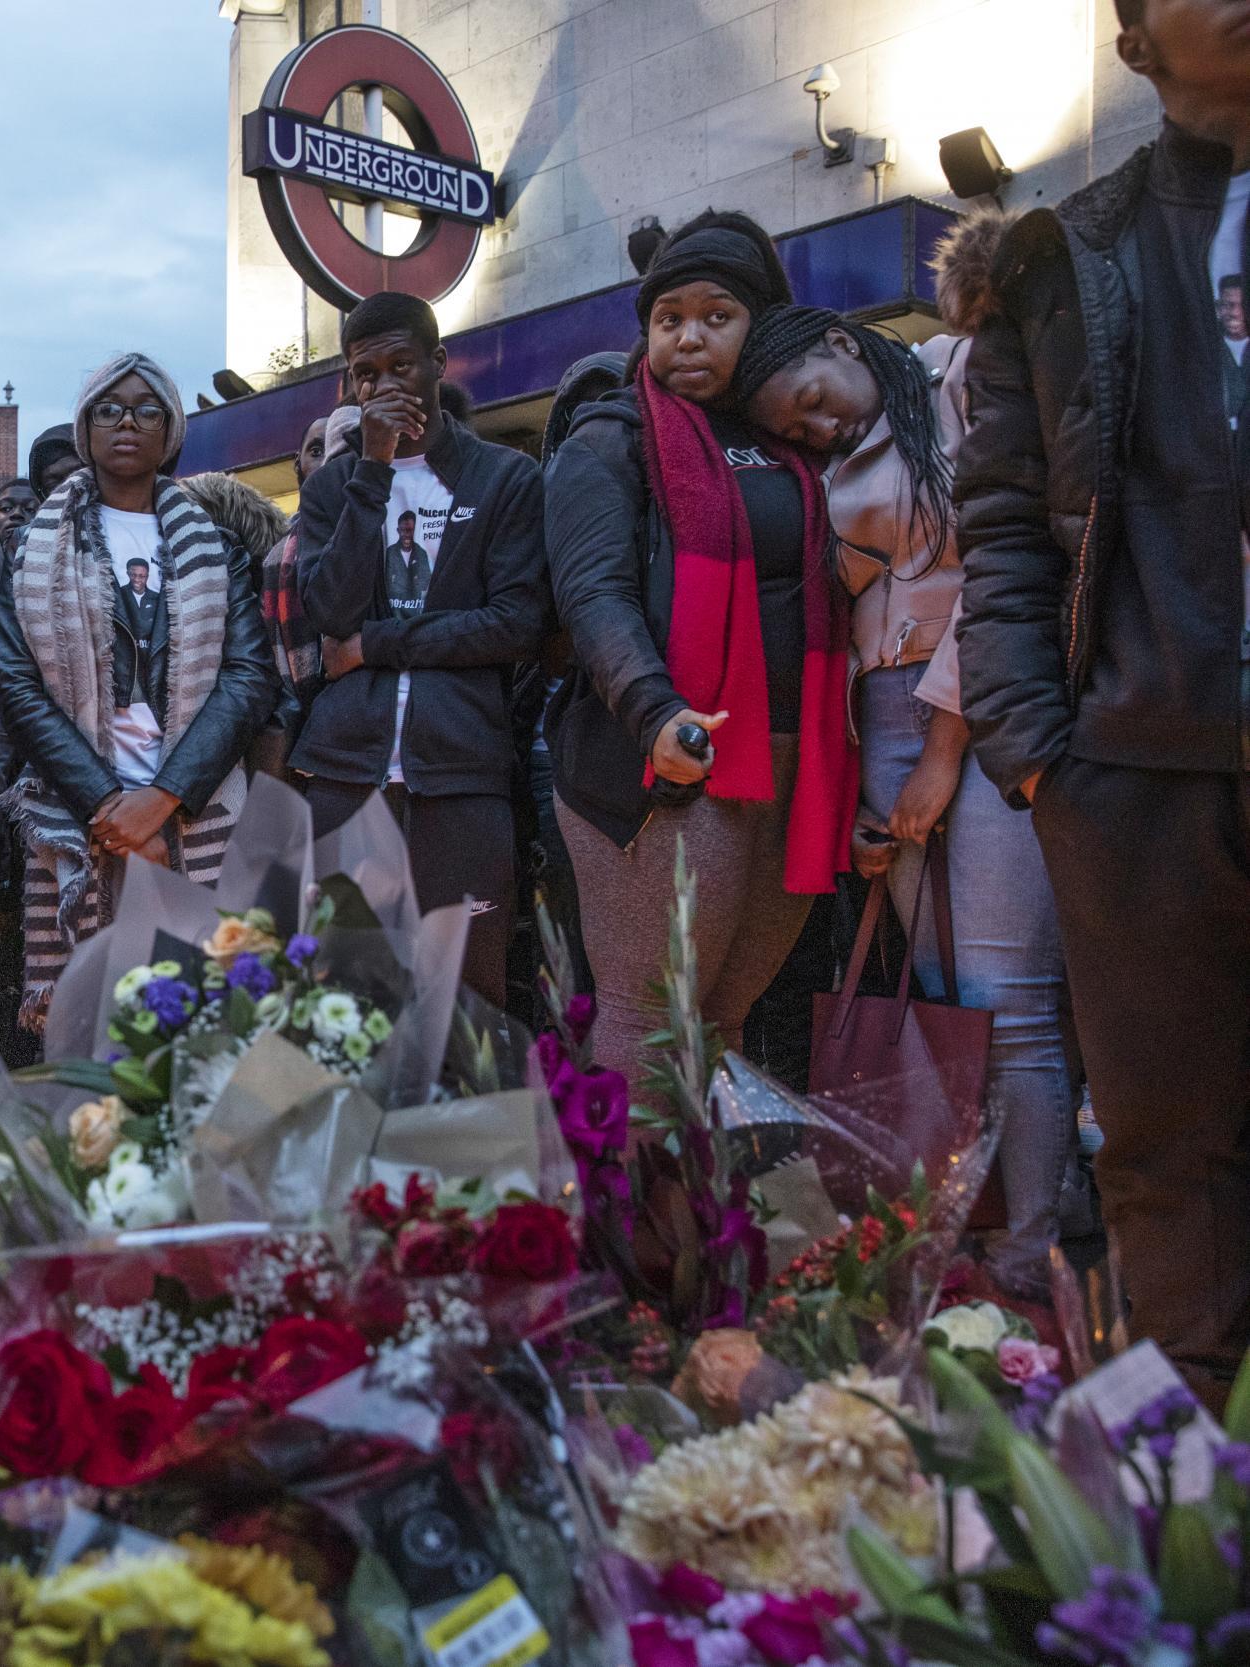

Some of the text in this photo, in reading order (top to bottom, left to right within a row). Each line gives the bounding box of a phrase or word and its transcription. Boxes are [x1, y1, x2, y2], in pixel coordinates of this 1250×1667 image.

[268, 115, 489, 217] UNDERGROUND
[418, 507, 449, 517] MALCOL
[455, 506, 476, 517] NIKE
[423, 520, 446, 530] FRESH
[423, 532, 443, 541] PRIN
